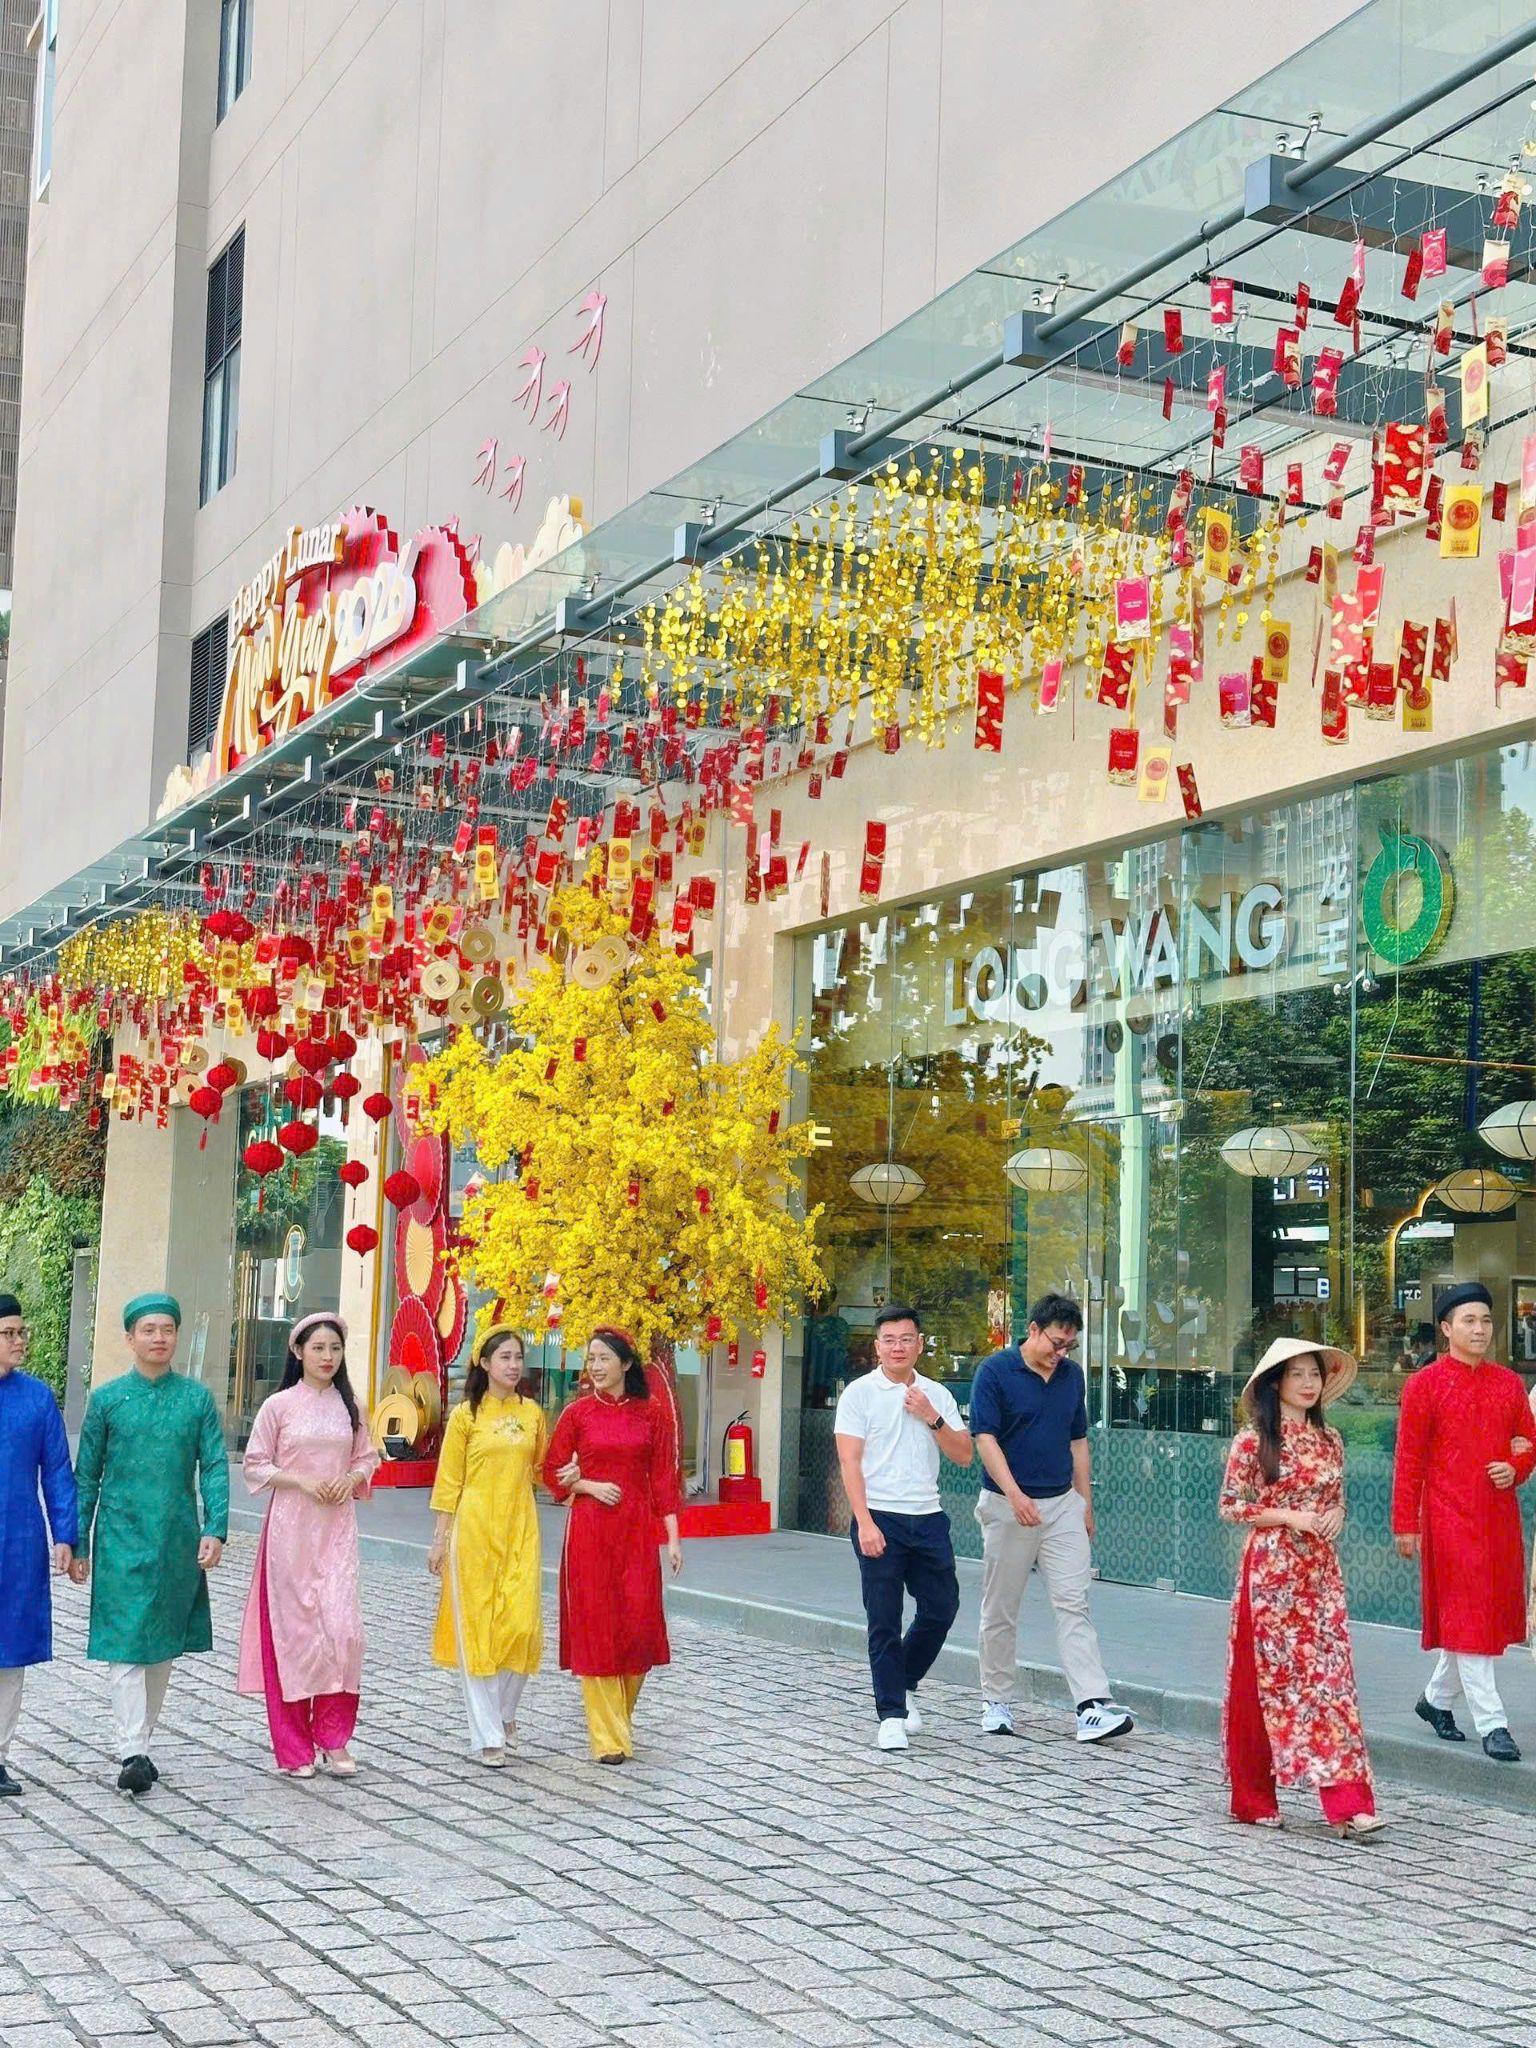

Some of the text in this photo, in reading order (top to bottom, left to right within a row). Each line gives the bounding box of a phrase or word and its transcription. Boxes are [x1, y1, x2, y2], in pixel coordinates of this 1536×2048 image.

[284, 523, 342, 580] Lunar
[216, 608, 275, 780] New
[330, 539, 417, 675] 2026
[944, 882, 1286, 1026] LONG WANG
